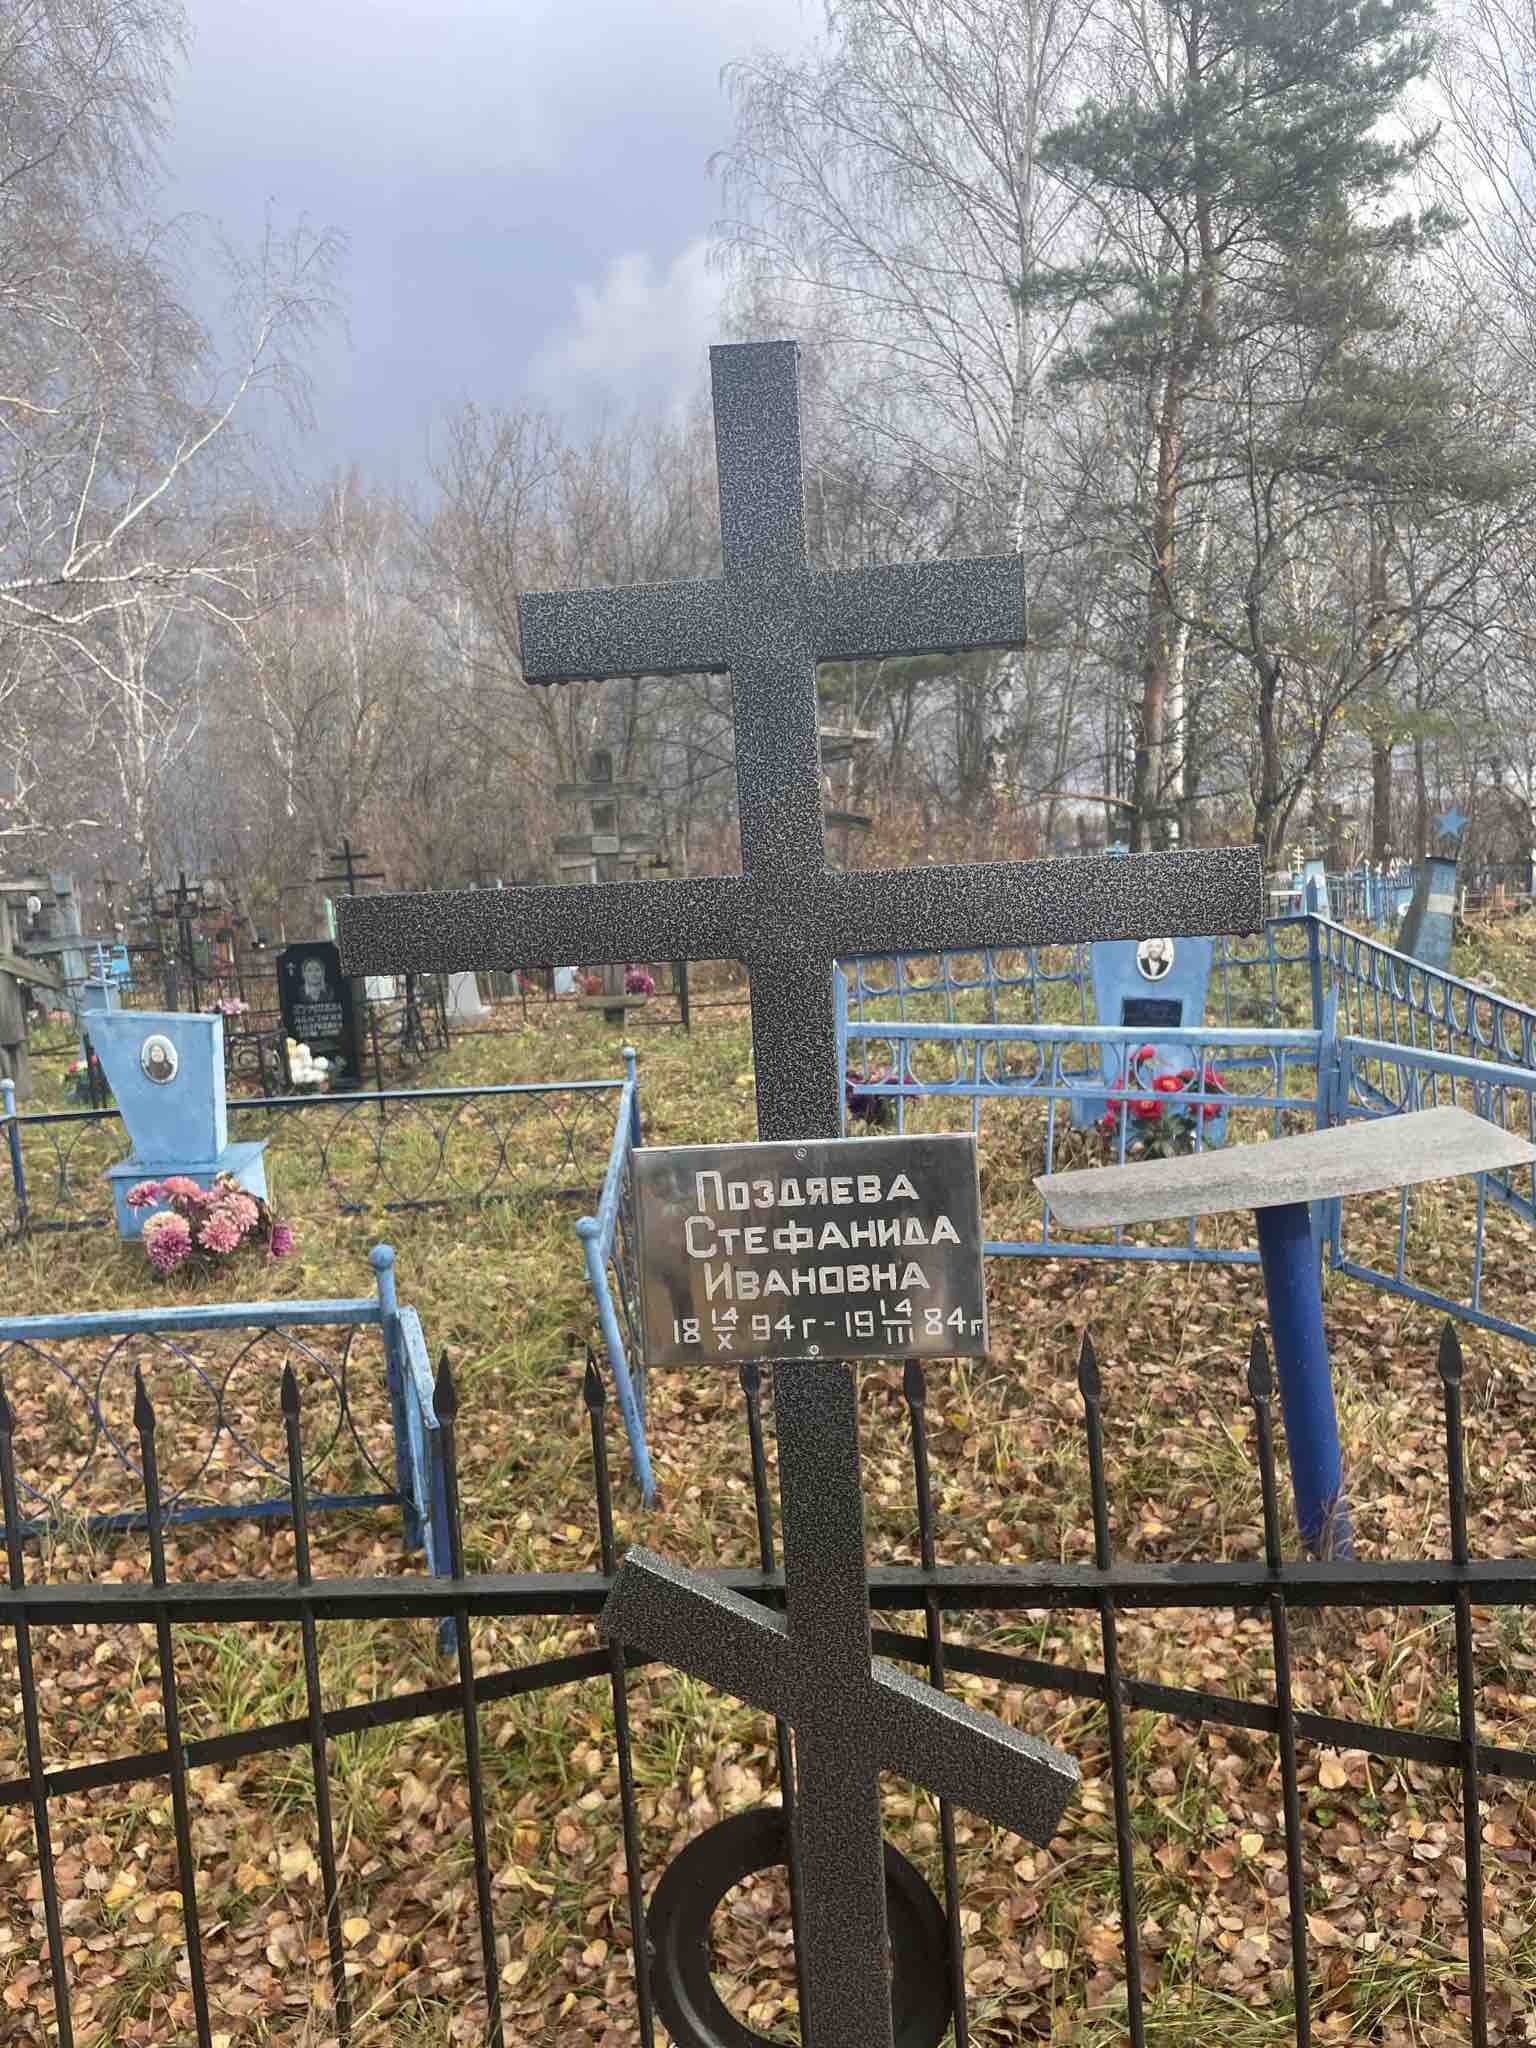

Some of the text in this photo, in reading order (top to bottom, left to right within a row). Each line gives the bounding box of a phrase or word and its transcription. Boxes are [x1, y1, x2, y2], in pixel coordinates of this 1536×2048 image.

[695, 1170, 920, 1212] ПОЗДЯЕВА
[684, 1215, 961, 1258] СТЕФАНИДА
[703, 1262, 930, 1301] ИВАНОВНА
[673, 1318, 701, 1344] 18
